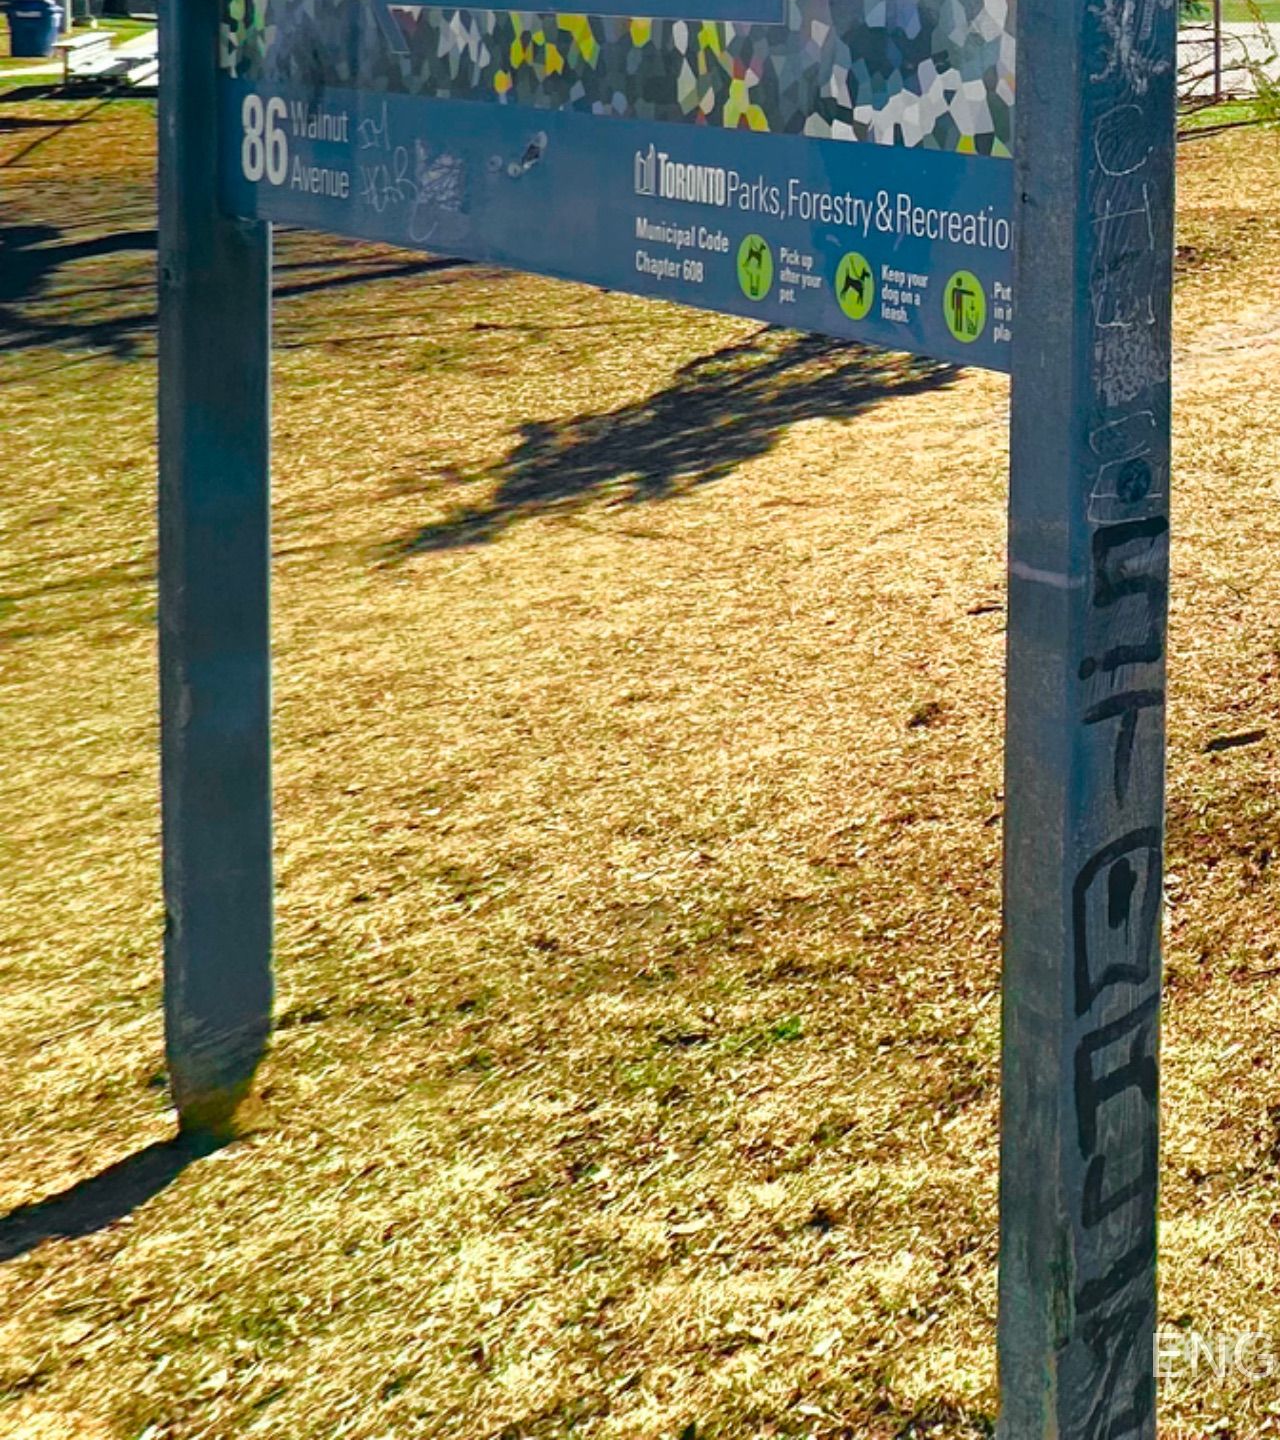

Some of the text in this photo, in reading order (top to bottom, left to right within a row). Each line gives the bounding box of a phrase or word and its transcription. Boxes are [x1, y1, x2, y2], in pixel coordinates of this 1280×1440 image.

[290, 100, 349, 143] Walnut
[241, 94, 288, 185] 86
[291, 154, 349, 200] Avenue
[657, 152, 1015, 251] TORONTO Parks, Forestry & Recreatio
[636, 217, 729, 253] Municipal Code
[636, 250, 680, 280] Chapter
[780, 247, 813, 271] Pick up
[780, 267, 822, 290] after your
[881, 264, 928, 288] Keep your
[881, 284, 921, 306] dog on a
